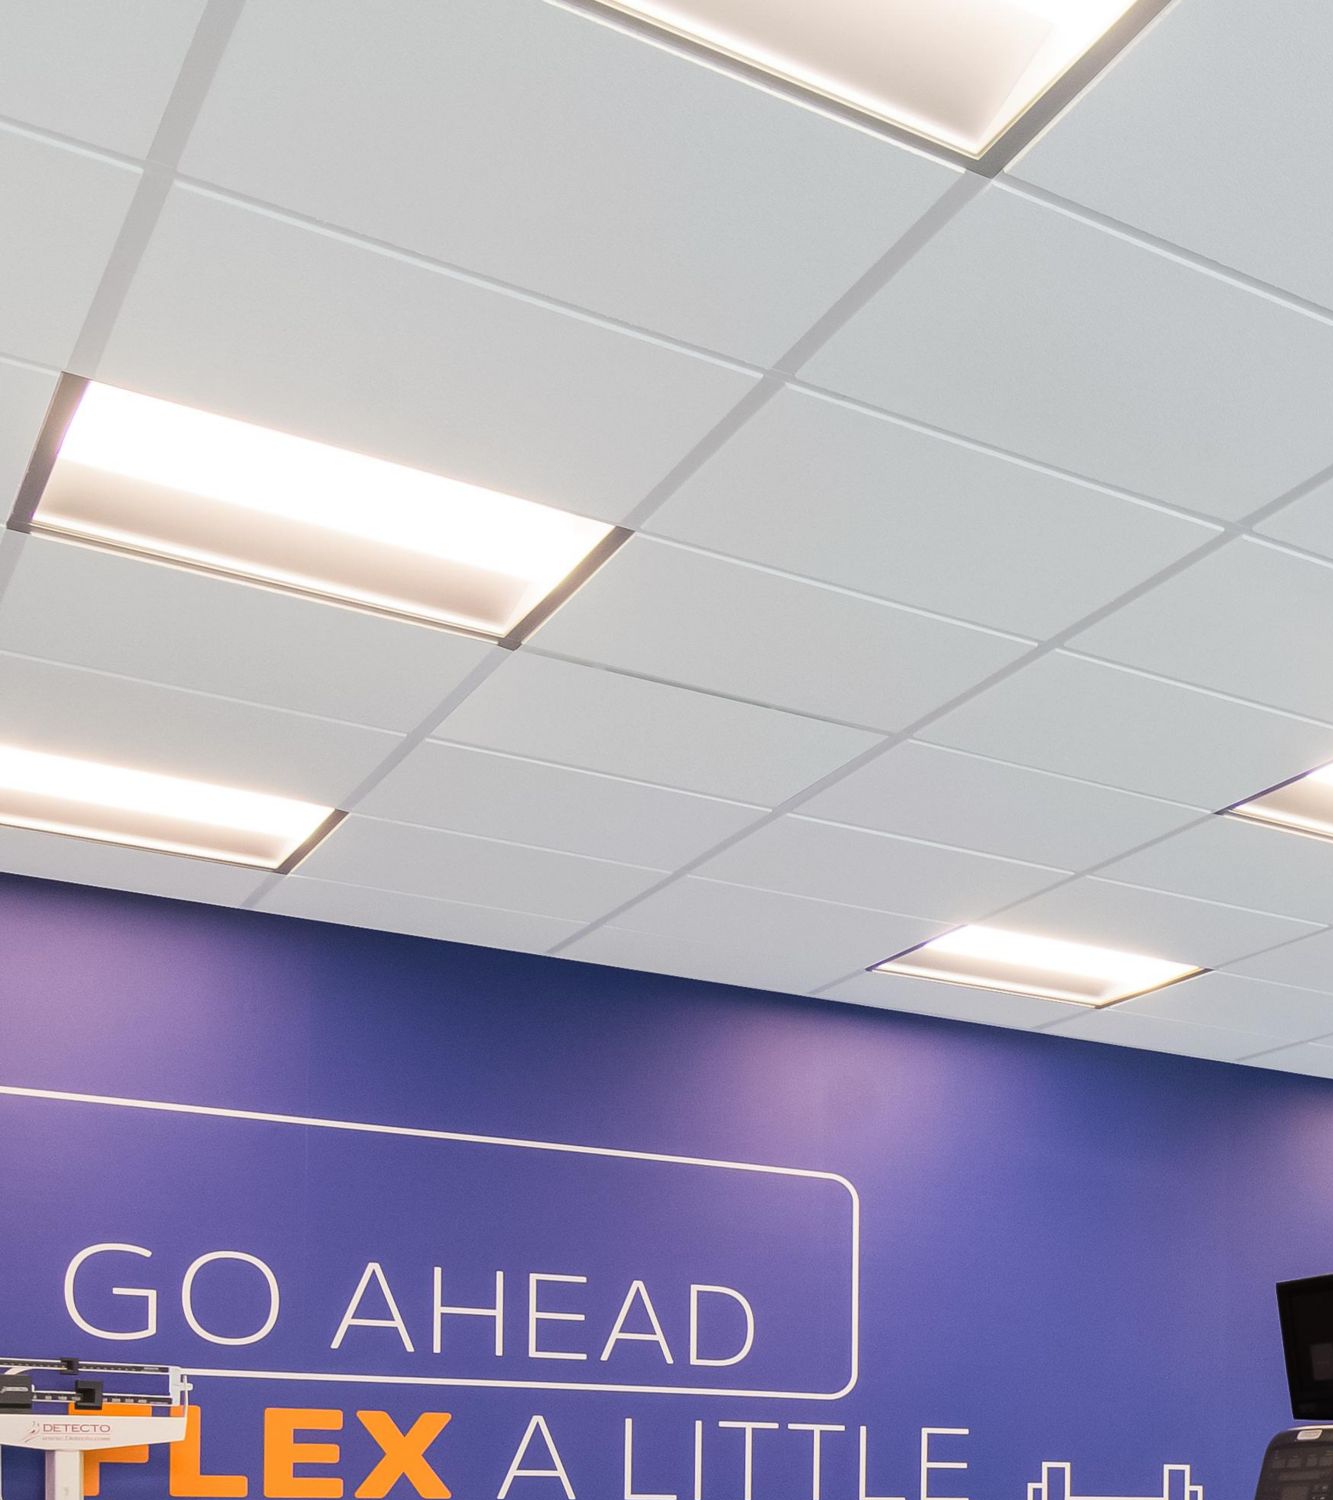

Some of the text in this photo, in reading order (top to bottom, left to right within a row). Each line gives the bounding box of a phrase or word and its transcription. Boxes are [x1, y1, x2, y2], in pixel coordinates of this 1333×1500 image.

[63, 1242, 757, 1368] GO AHEAD
[43, 1423, 111, 1433] DETECTO
[497, 1415, 577, 1500] A
